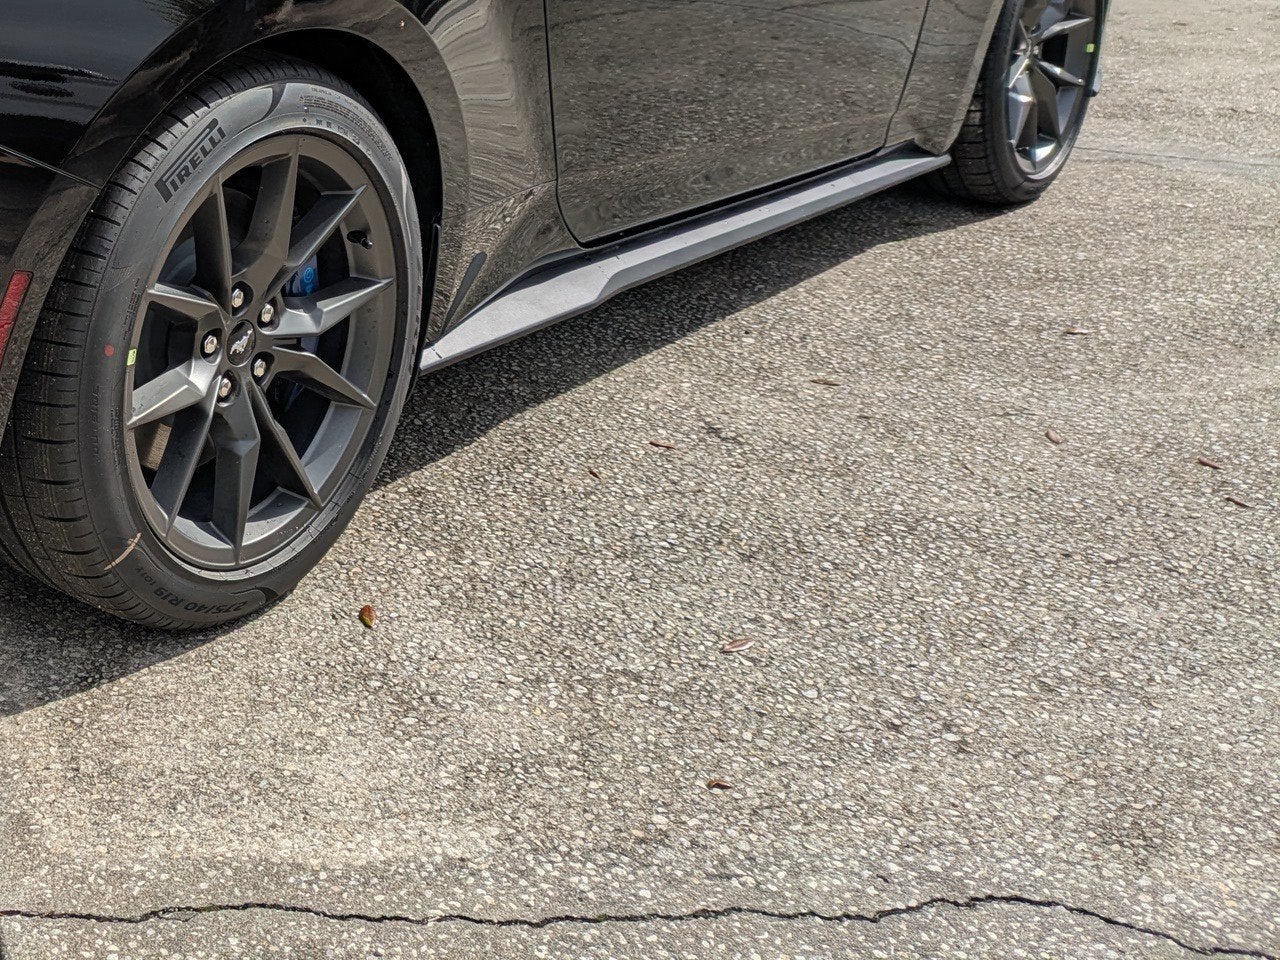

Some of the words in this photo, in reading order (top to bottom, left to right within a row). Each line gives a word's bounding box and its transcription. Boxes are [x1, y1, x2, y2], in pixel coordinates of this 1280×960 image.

[154, 117, 227, 203] PIRELLI
[153, 587, 184, 607] R19
[184, 601, 248, 615] 275/40
